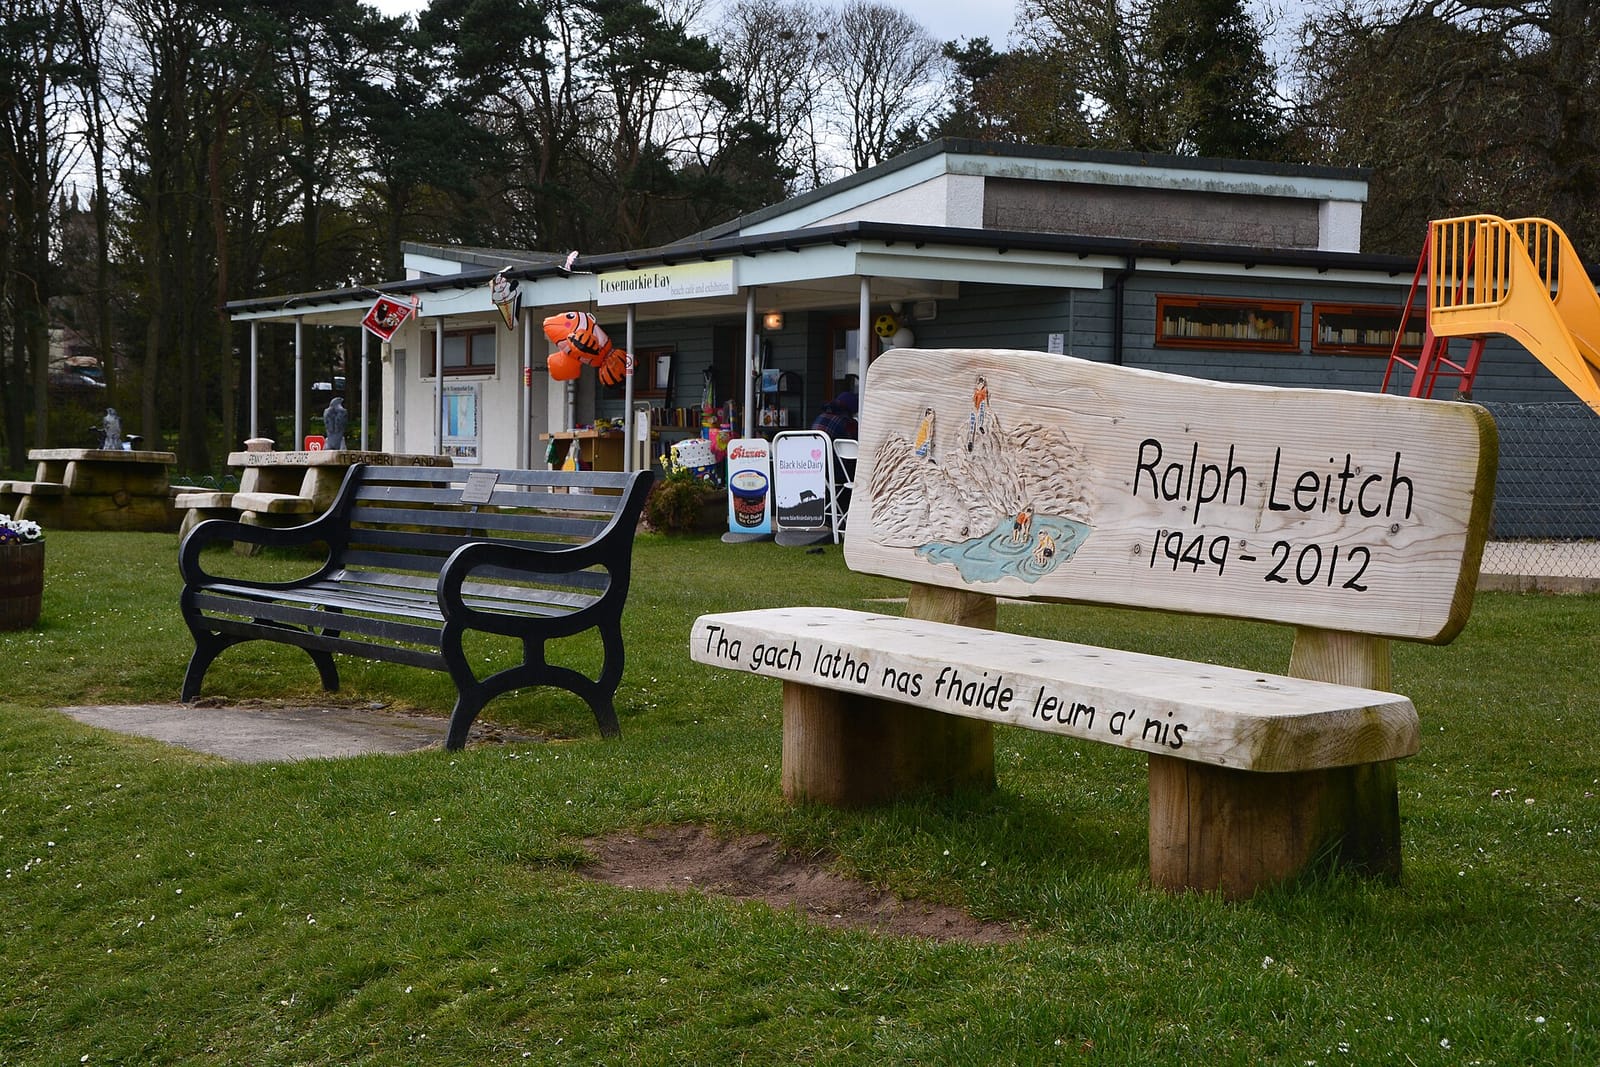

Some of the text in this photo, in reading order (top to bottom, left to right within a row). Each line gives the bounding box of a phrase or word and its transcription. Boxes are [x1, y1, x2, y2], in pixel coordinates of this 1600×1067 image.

[654, 273, 670, 288] Bay
[342, 453, 390, 466] TEACHER
[413, 456, 436, 467] AND
[780, 459, 824, 472] Black Isle Dairy
[1133, 438, 1414, 525] Ralph Leitch
[706, 625, 742, 662] Tha
[749, 640, 802, 671] gach
[813, 644, 870, 685] latha
[881, 667, 923, 697] nas
[934, 666, 1014, 712] fhaide
[1032, 686, 1096, 730] leum
[1142, 711, 1188, 750] nis
